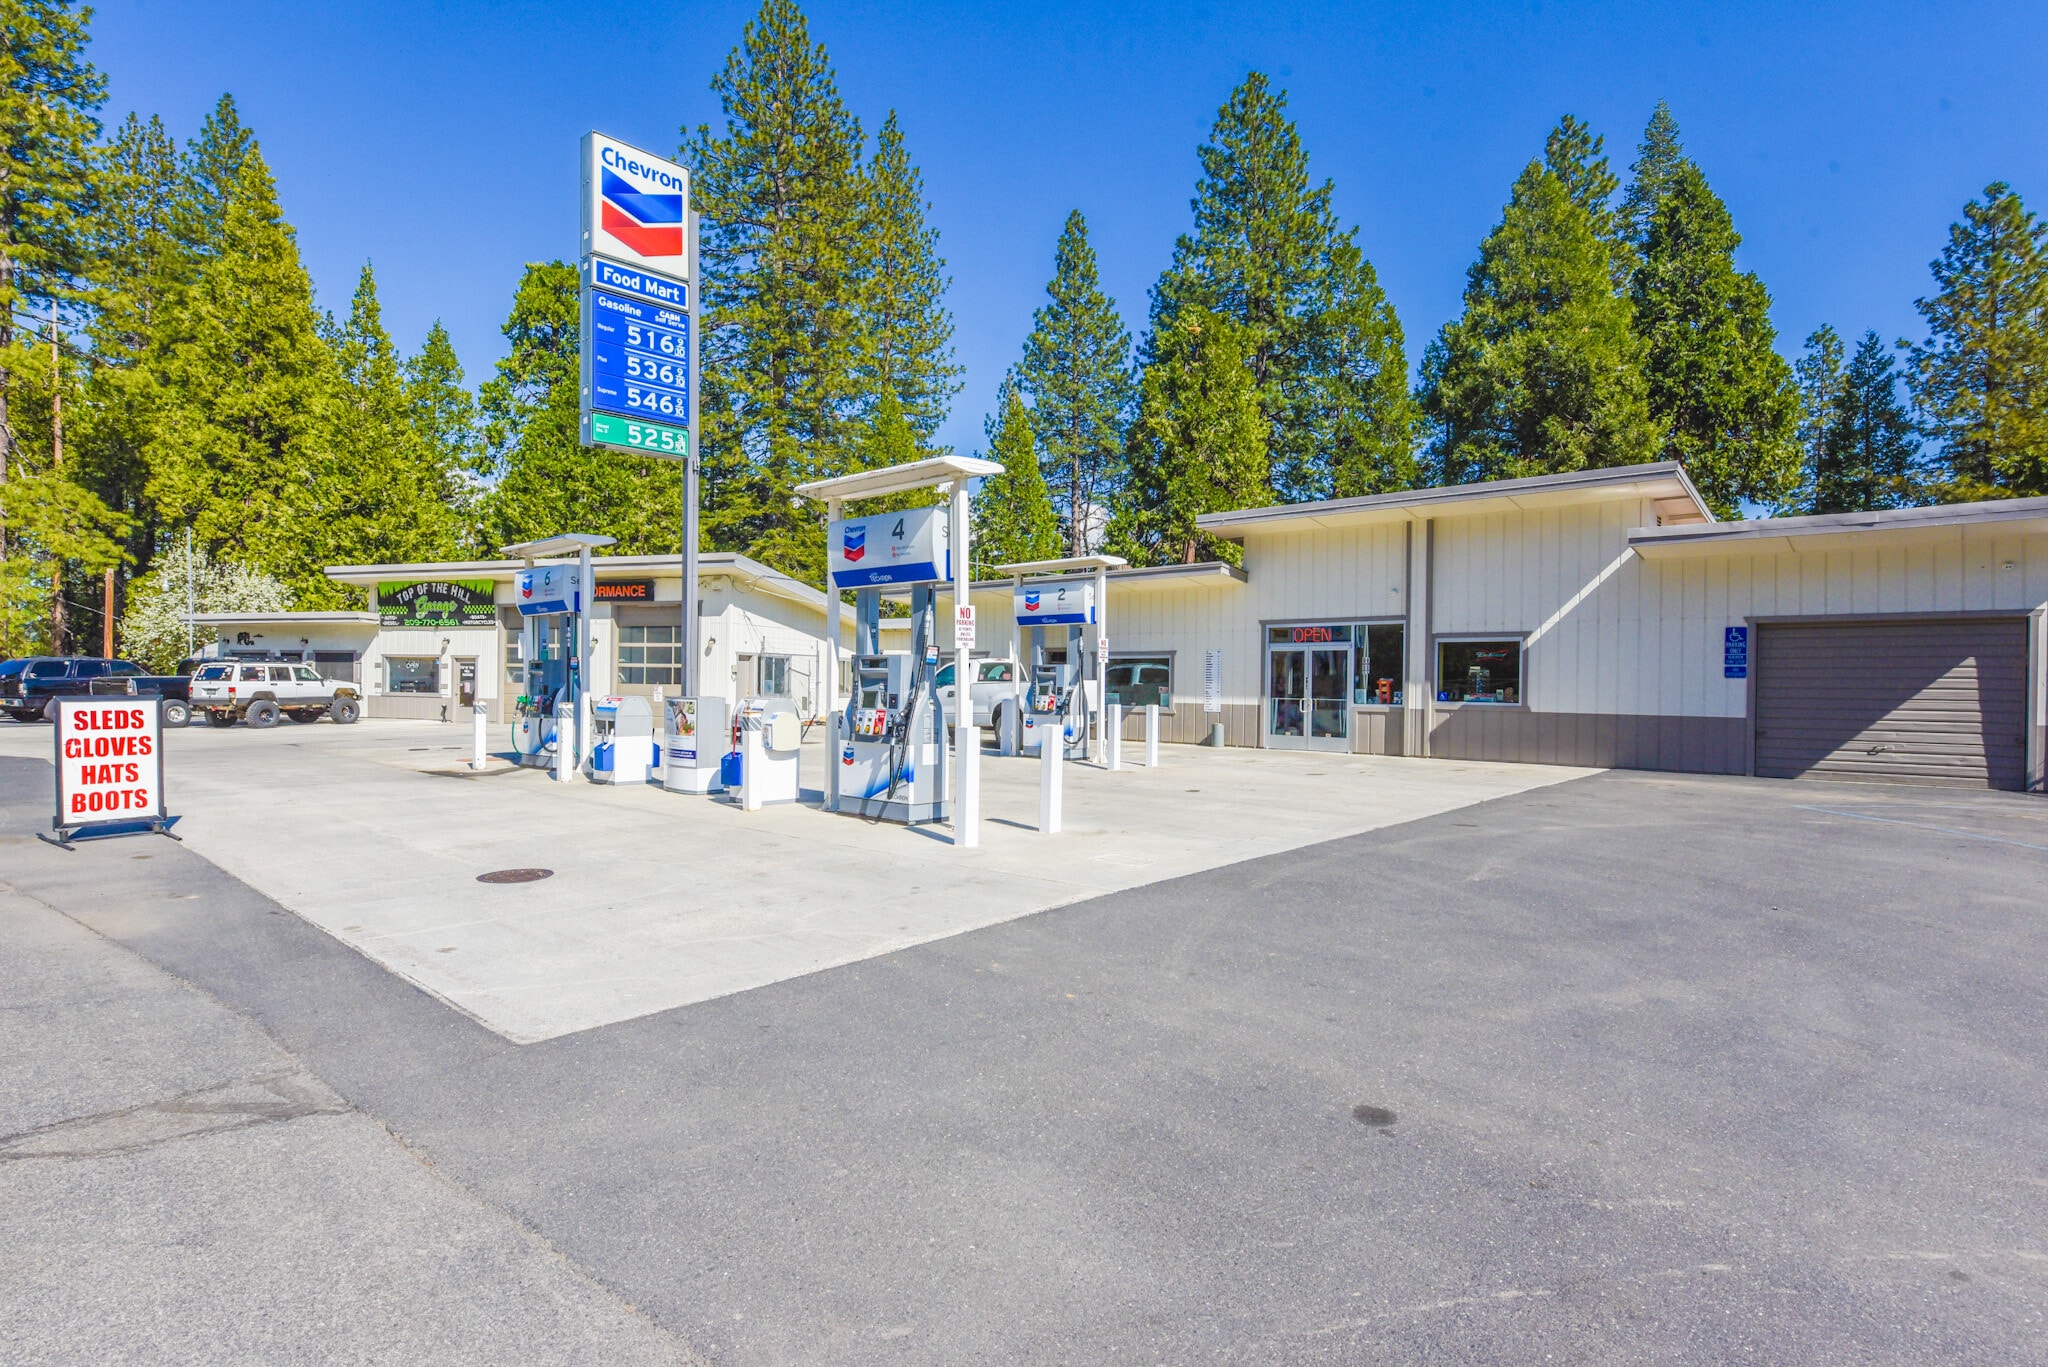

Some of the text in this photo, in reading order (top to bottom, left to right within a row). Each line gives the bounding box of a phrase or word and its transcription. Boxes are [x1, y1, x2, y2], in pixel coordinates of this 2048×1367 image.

[601, 146, 682, 192] Chevron
[603, 266, 680, 301] Food Mart
[598, 296, 642, 316] Gasoline
[659, 310, 681, 321] CASH
[655, 315, 685, 329] Self Serve
[627, 325, 674, 353] 516
[597, 355, 608, 363] Plus
[627, 356, 674, 383] 536
[627, 387, 674, 414] 546
[628, 425, 674, 450] 525
[844, 525, 866, 534] Chevron
[891, 518, 905, 540] 4
[544, 571, 551, 586] 6
[397, 582, 471, 604] TOP OF THE HILL
[594, 585, 646, 597] ORMANCE
[1057, 588, 1066, 601] 2
[414, 595, 458, 619] Garage
[960, 607, 971, 619] NO
[1294, 627, 1332, 643] OPEN
[74, 710, 144, 730] SLEDS
[65, 735, 152, 759] GLOVES
[81, 763, 139, 785] HATS
[71, 789, 148, 813] BOOTS
